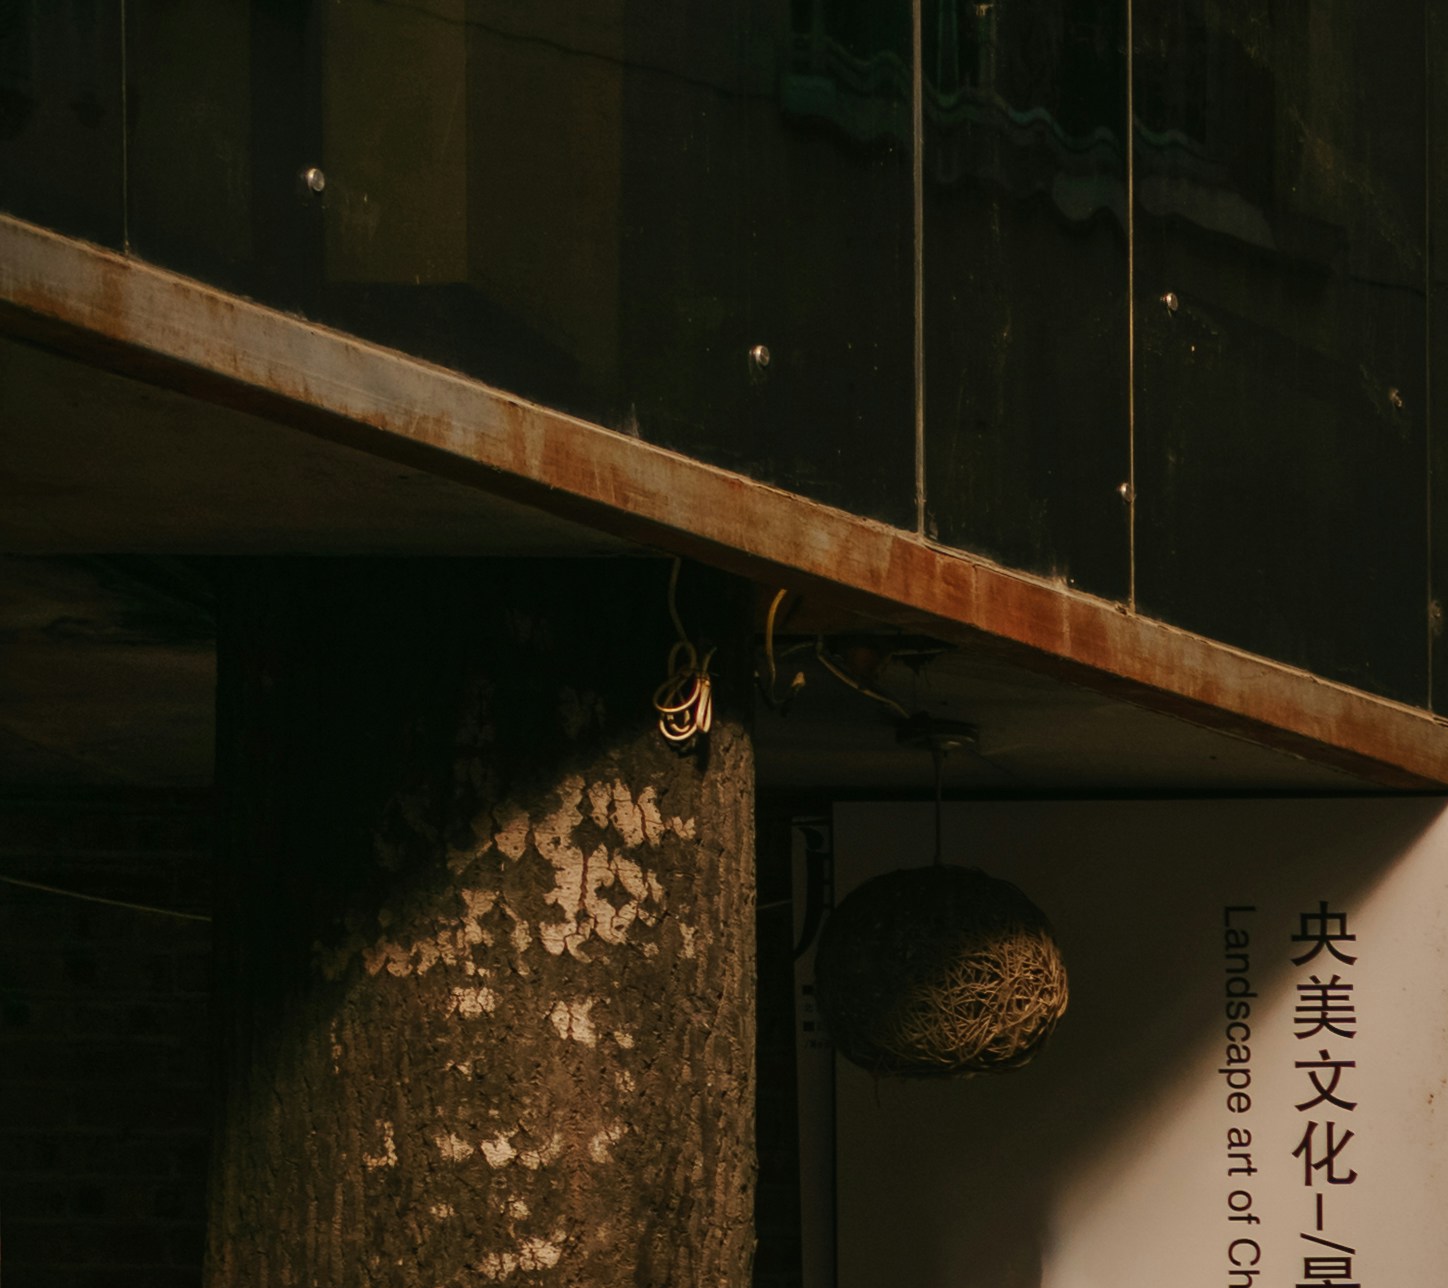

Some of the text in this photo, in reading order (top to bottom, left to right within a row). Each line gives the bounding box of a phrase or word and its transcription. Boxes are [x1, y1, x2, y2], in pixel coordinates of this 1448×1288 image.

[1219, 904, 1258, 1114] Landscape
[1227, 1126, 1258, 1178] art
[1227, 1189, 1261, 1226] of
